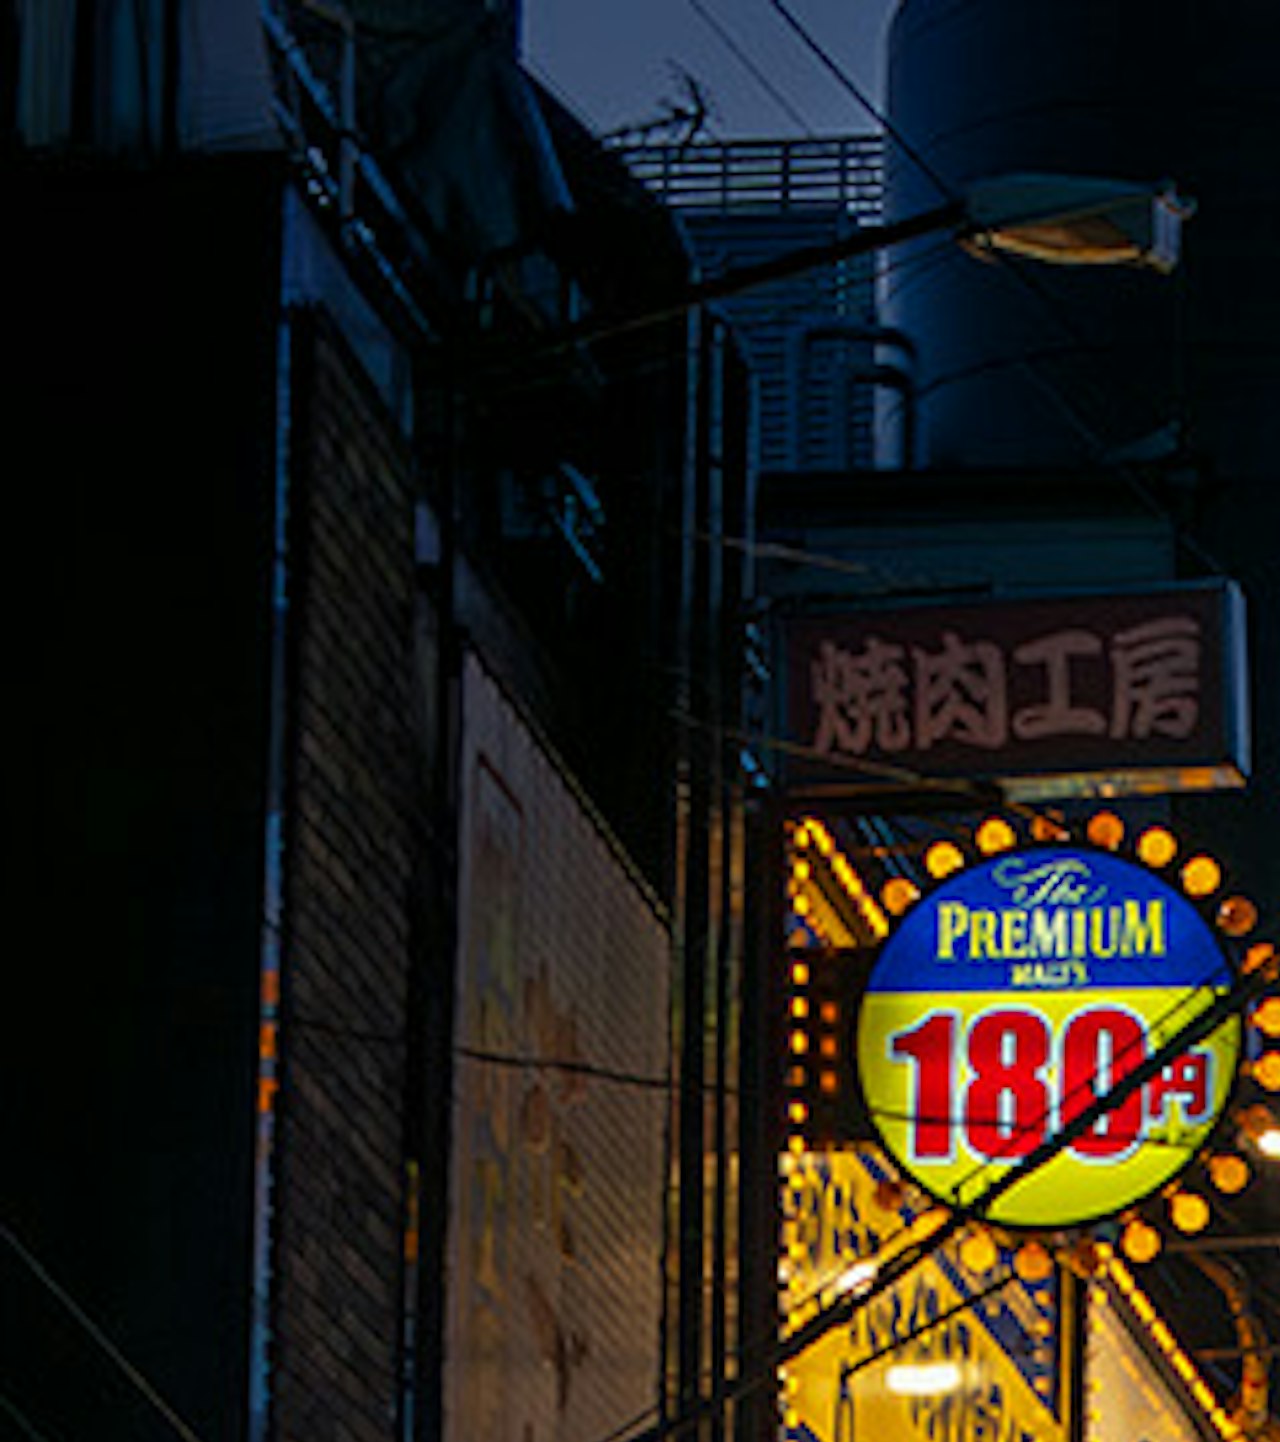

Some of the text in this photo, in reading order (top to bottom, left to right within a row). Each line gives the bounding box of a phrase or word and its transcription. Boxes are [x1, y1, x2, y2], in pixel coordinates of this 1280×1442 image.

[808, 615, 1202, 756] 焼肉工房
[935, 899, 1167, 962] PREMIUM
